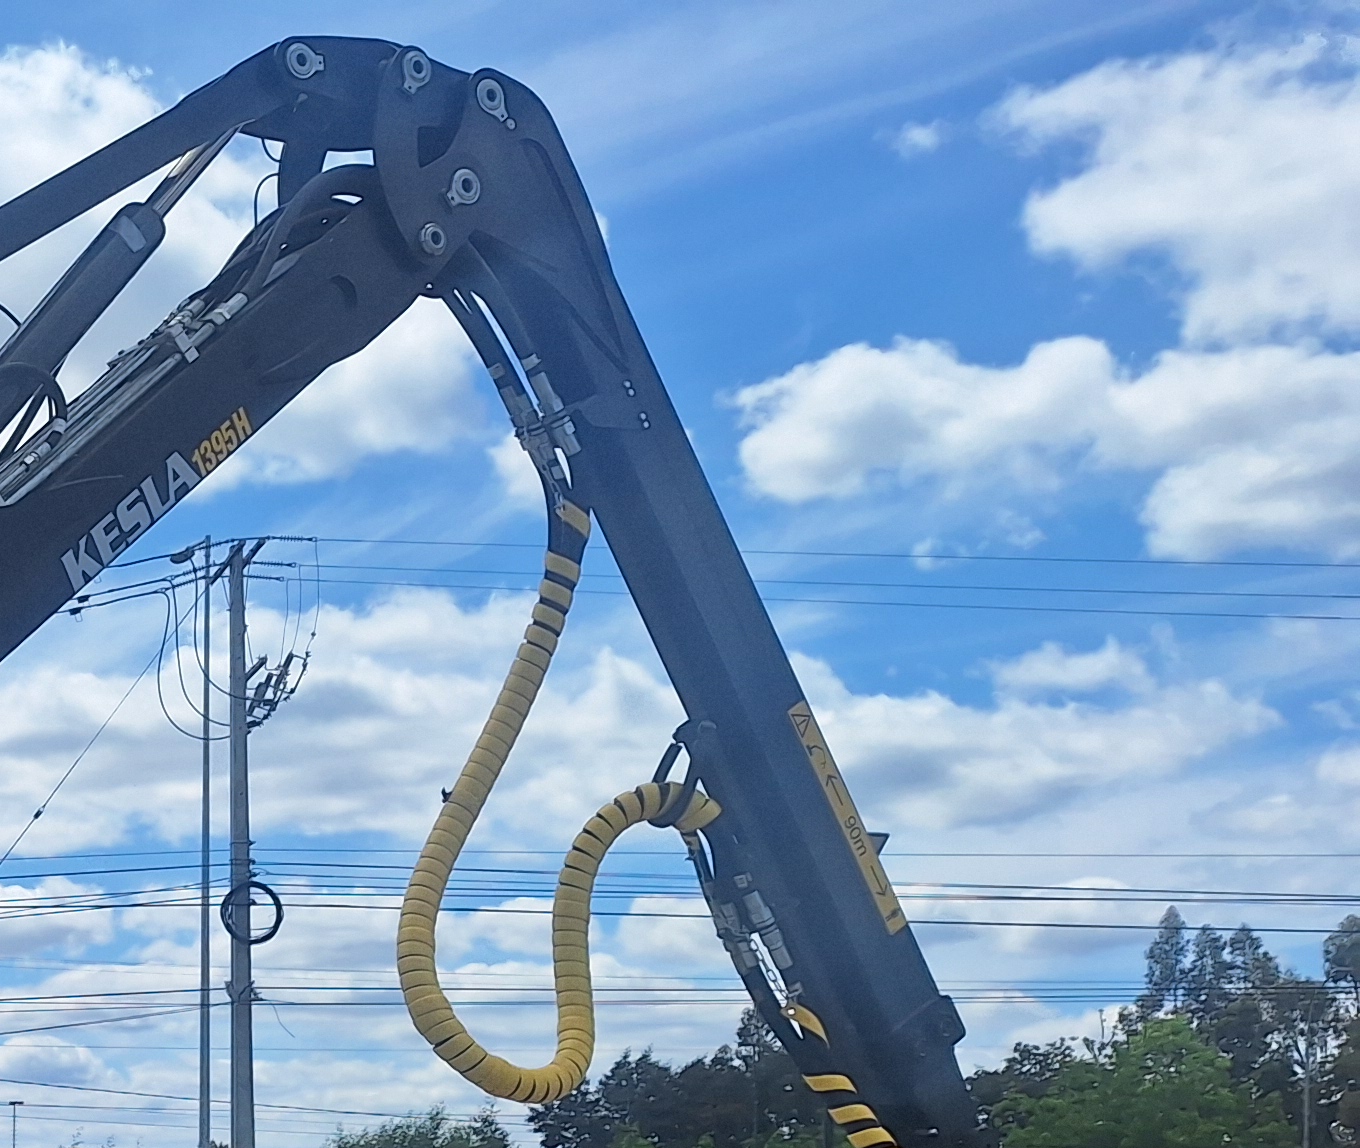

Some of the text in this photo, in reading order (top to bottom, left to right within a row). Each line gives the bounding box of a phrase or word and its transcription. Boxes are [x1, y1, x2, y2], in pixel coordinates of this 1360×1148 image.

[60, 406, 253, 594] KESLA 1395H
[844, 815, 867, 857] 90m
